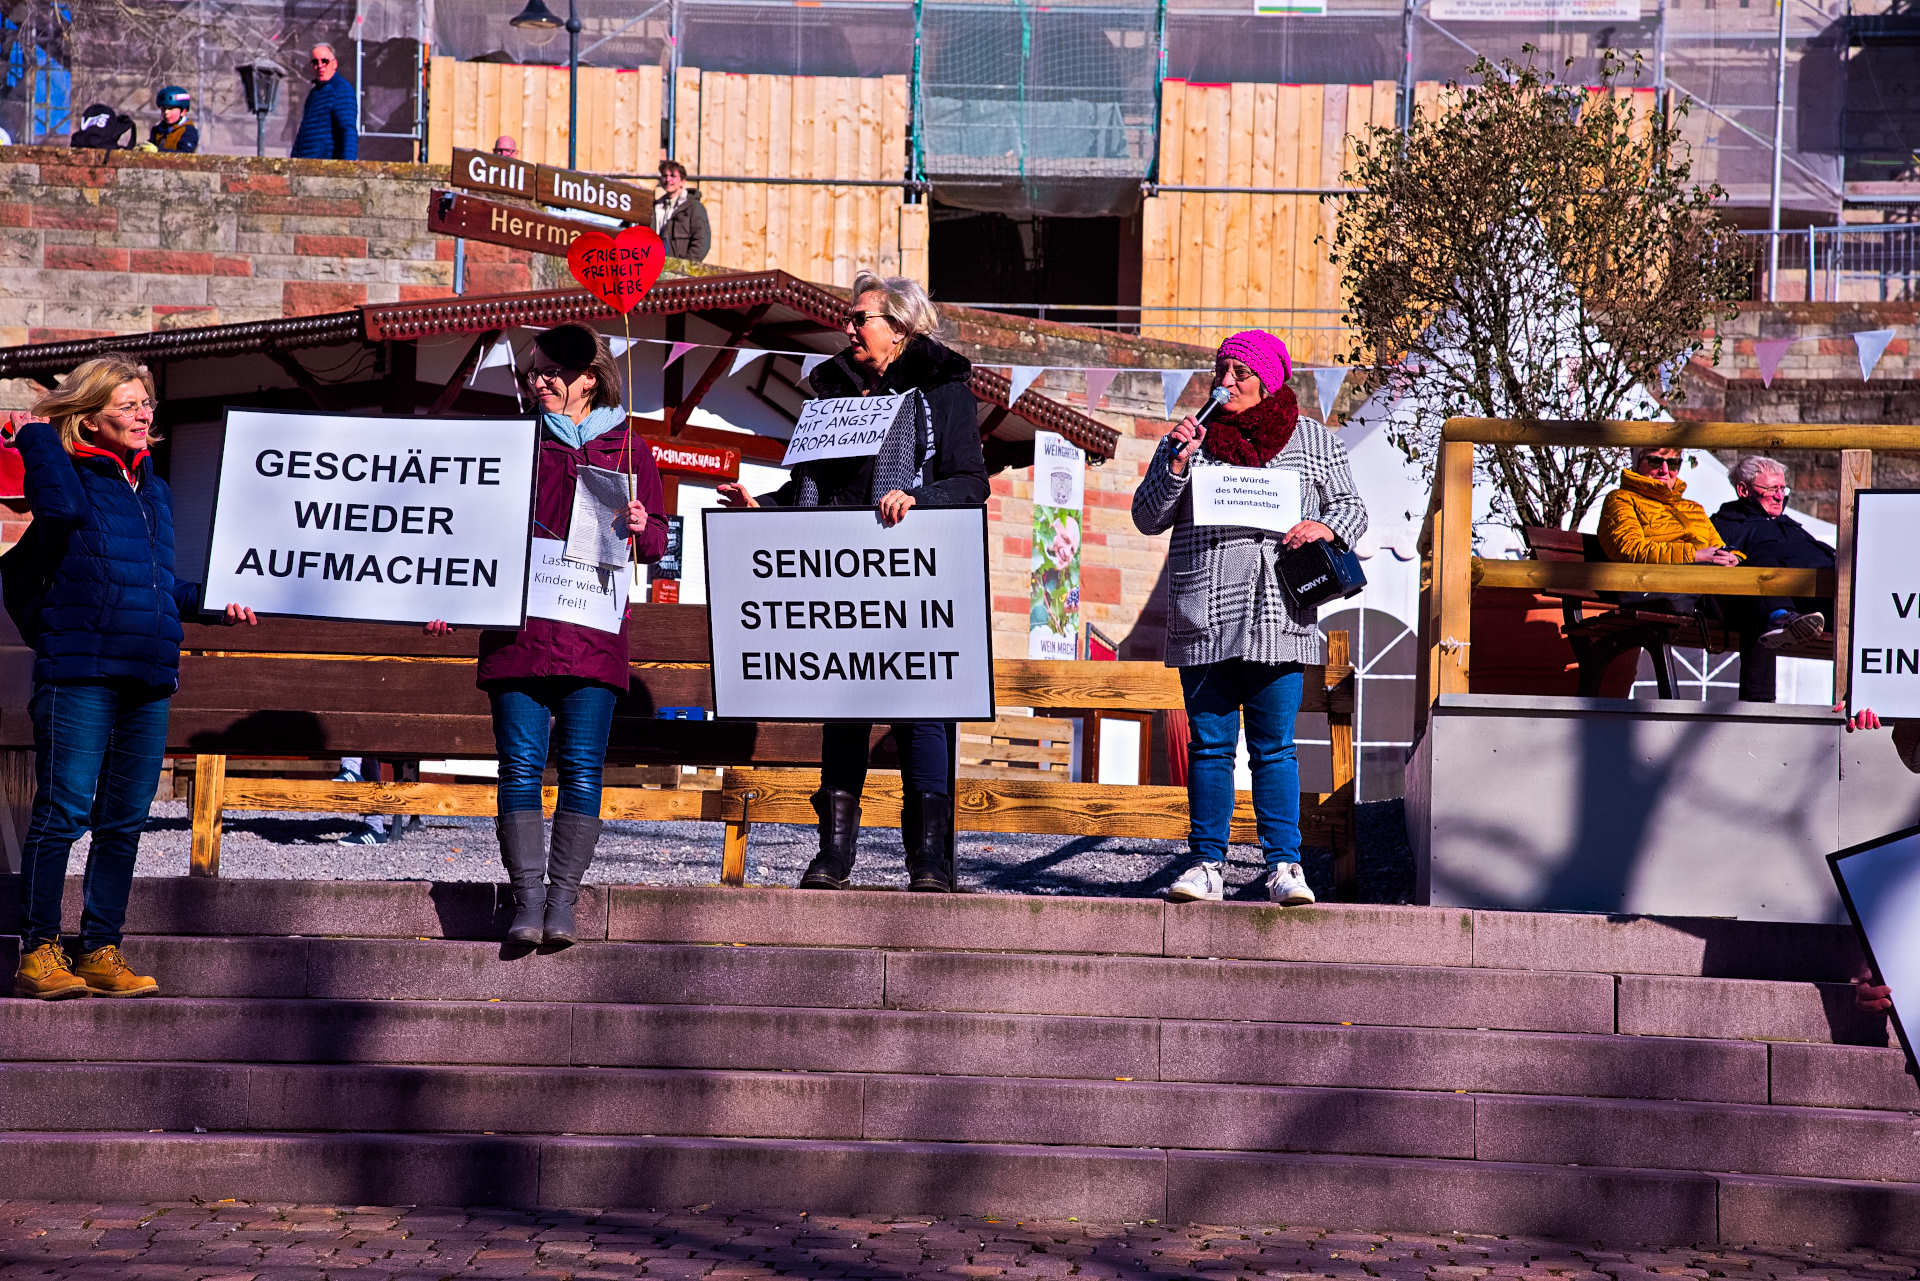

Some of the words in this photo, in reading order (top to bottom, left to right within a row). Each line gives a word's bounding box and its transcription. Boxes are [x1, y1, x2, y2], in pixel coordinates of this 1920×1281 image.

[468, 156, 525, 191] Grill
[553, 173, 632, 212] Imbiss
[582, 263, 644, 280] FREIHEIT
[602, 279, 643, 296] LIEBE
[805, 397, 897, 418] SCHLUSS
[795, 420, 822, 435] MIT
[825, 413, 889, 430] ANGST-
[789, 428, 886, 455] PROPAGANDA
[255, 448, 502, 486] GESCHÄFTE
[652, 446, 721, 468] FACHWERKHAUS
[1223, 475, 1238, 483] Die
[1239, 476, 1270, 485] Würde
[1215, 486, 1231, 494] des
[1233, 487, 1278, 497] Menschen
[1227, 499, 1280, 509] unantastbar
[294, 500, 454, 536] WIEDER
[234, 547, 498, 588] AUFMACHEN
[542, 553, 571, 568] Lasst
[752, 547, 937, 579] SENIOREN
[534, 571, 573, 588] Kinder
[1297, 574, 1328, 594] VONYX
[557, 594, 587, 610] frei!!
[740, 600, 907, 630] STERBEN
[920, 599, 954, 629] IN
[741, 651, 960, 681] EINSAMKEIT
